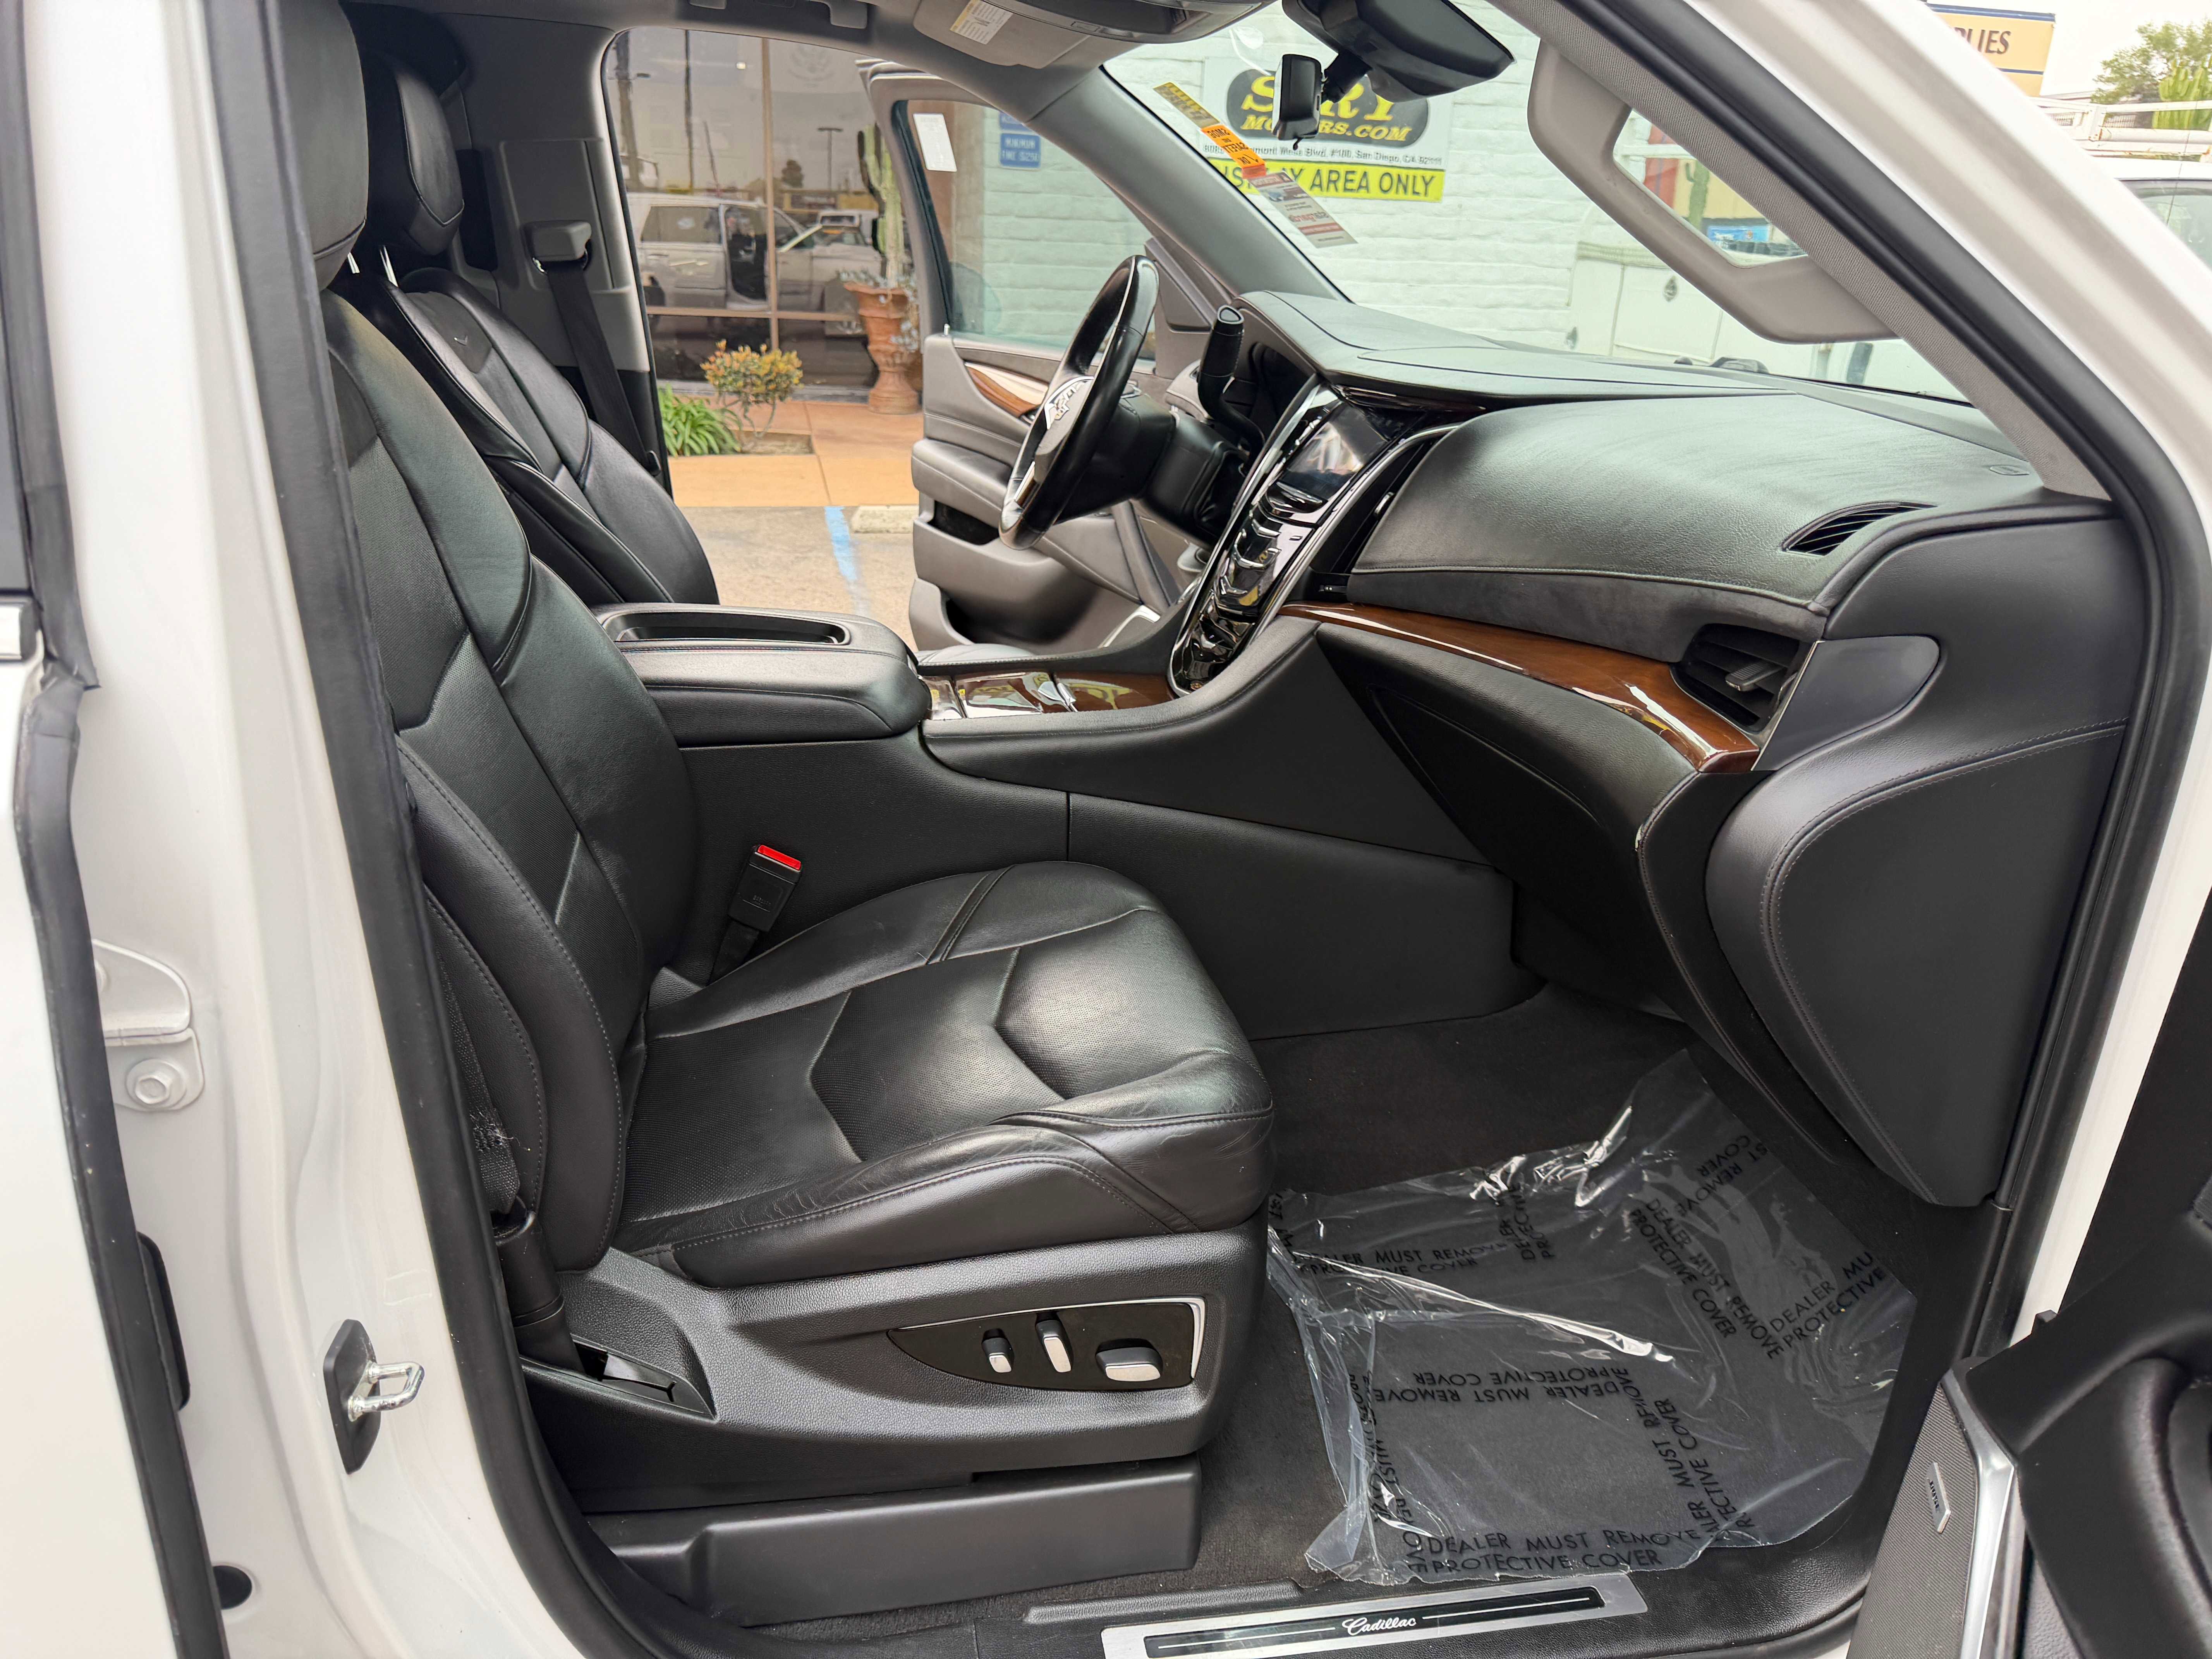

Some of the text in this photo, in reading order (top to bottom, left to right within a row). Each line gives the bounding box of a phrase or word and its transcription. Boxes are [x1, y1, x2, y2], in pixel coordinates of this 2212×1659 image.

[1240, 115, 1412, 141] MRS.COM
[1309, 169, 1369, 193] AREA
[1379, 172, 1436, 197] ONLY
[1375, 1249, 1422, 1264] MUST
[1629, 1208, 1737, 1338] PROTECTIVE COVER
[1645, 1198, 1692, 1250] DEALER
[1732, 1295, 1784, 1360] REMOVE
[1769, 1280, 1836, 1333] DEALER
[1782, 1266, 1886, 1348] PROTECTIVE
[1413, 1366, 1611, 1386] PROTECTIVE COVER
[1373, 1381, 1620, 1403] DEALER MUST REMOVE
[1654, 1398, 1697, 1450] COVER
[1652, 1439, 1695, 1488] MUST
[1428, 1529, 1701, 1554] DEALER MUST REMOVE
[1432, 1549, 1662, 1573] PROTECTIVE COVER
[1342, 1617, 1417, 1636] Cadillac
